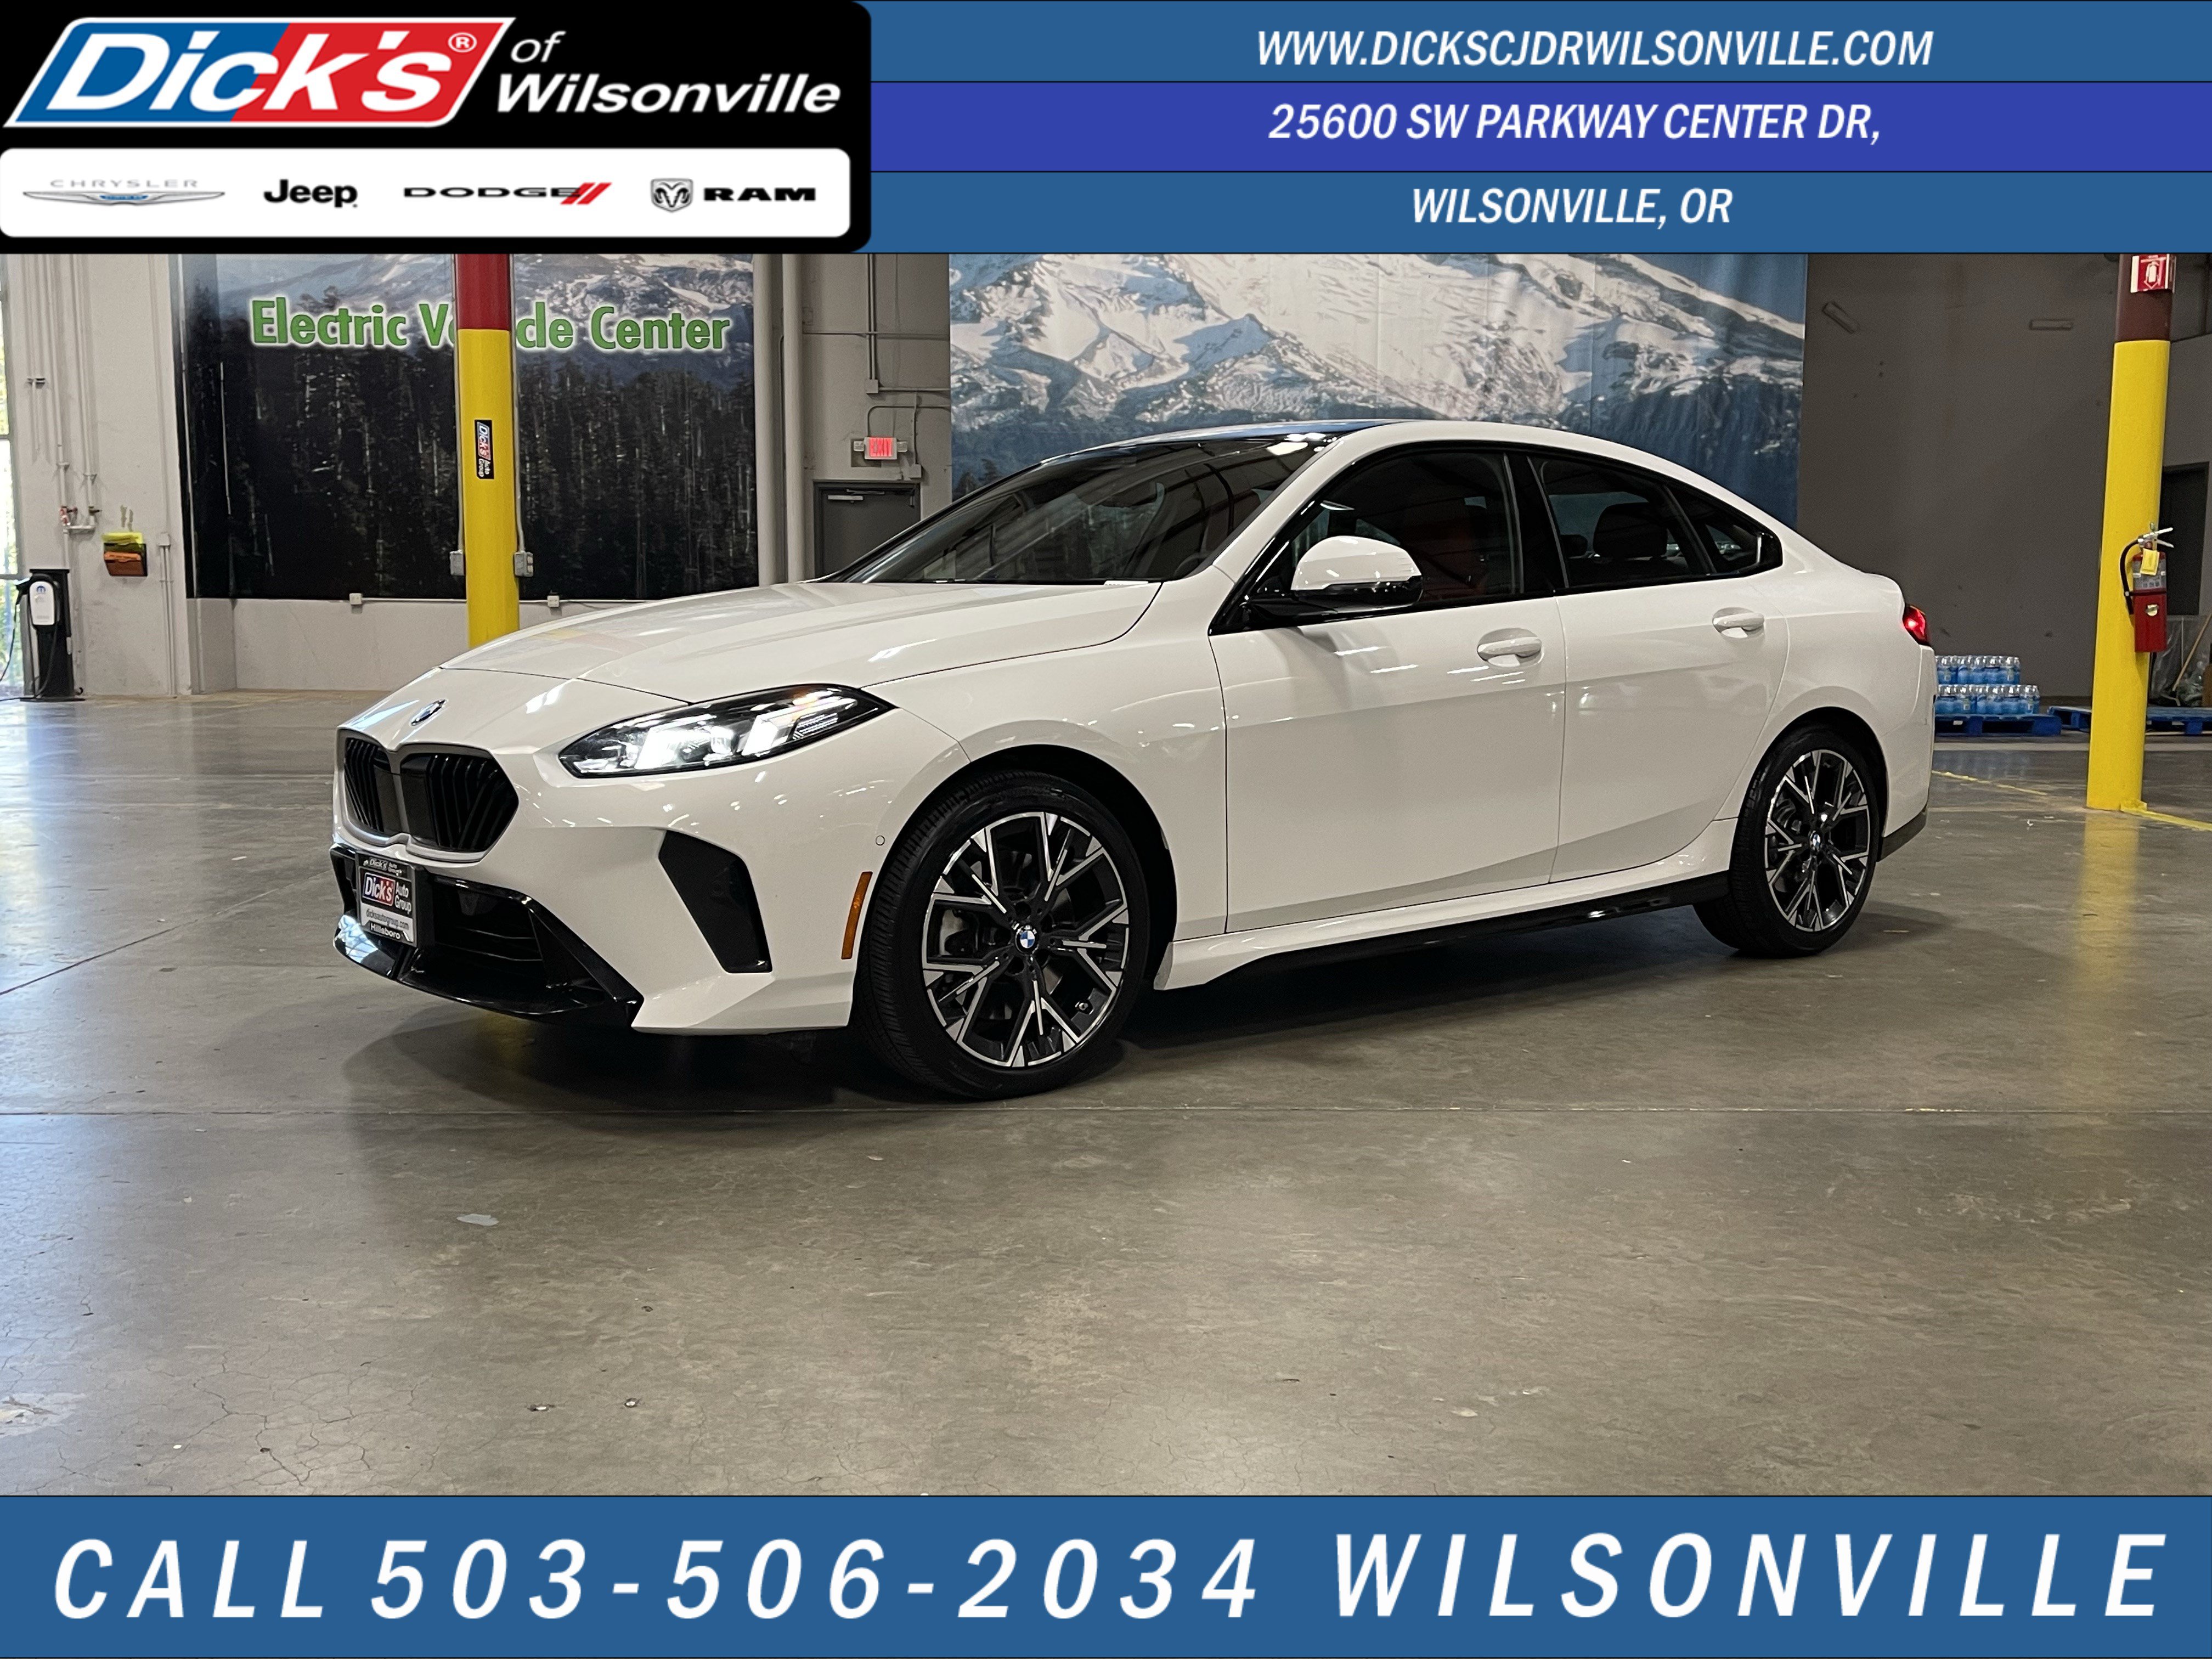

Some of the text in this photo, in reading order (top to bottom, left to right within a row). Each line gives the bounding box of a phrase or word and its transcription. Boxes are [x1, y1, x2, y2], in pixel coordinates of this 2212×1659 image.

[252, 297, 730, 349] Electric Vcle Center
[364, 877, 393, 902] Dick's
[396, 882, 409, 898] Auto
[395, 895, 411, 915] Group
